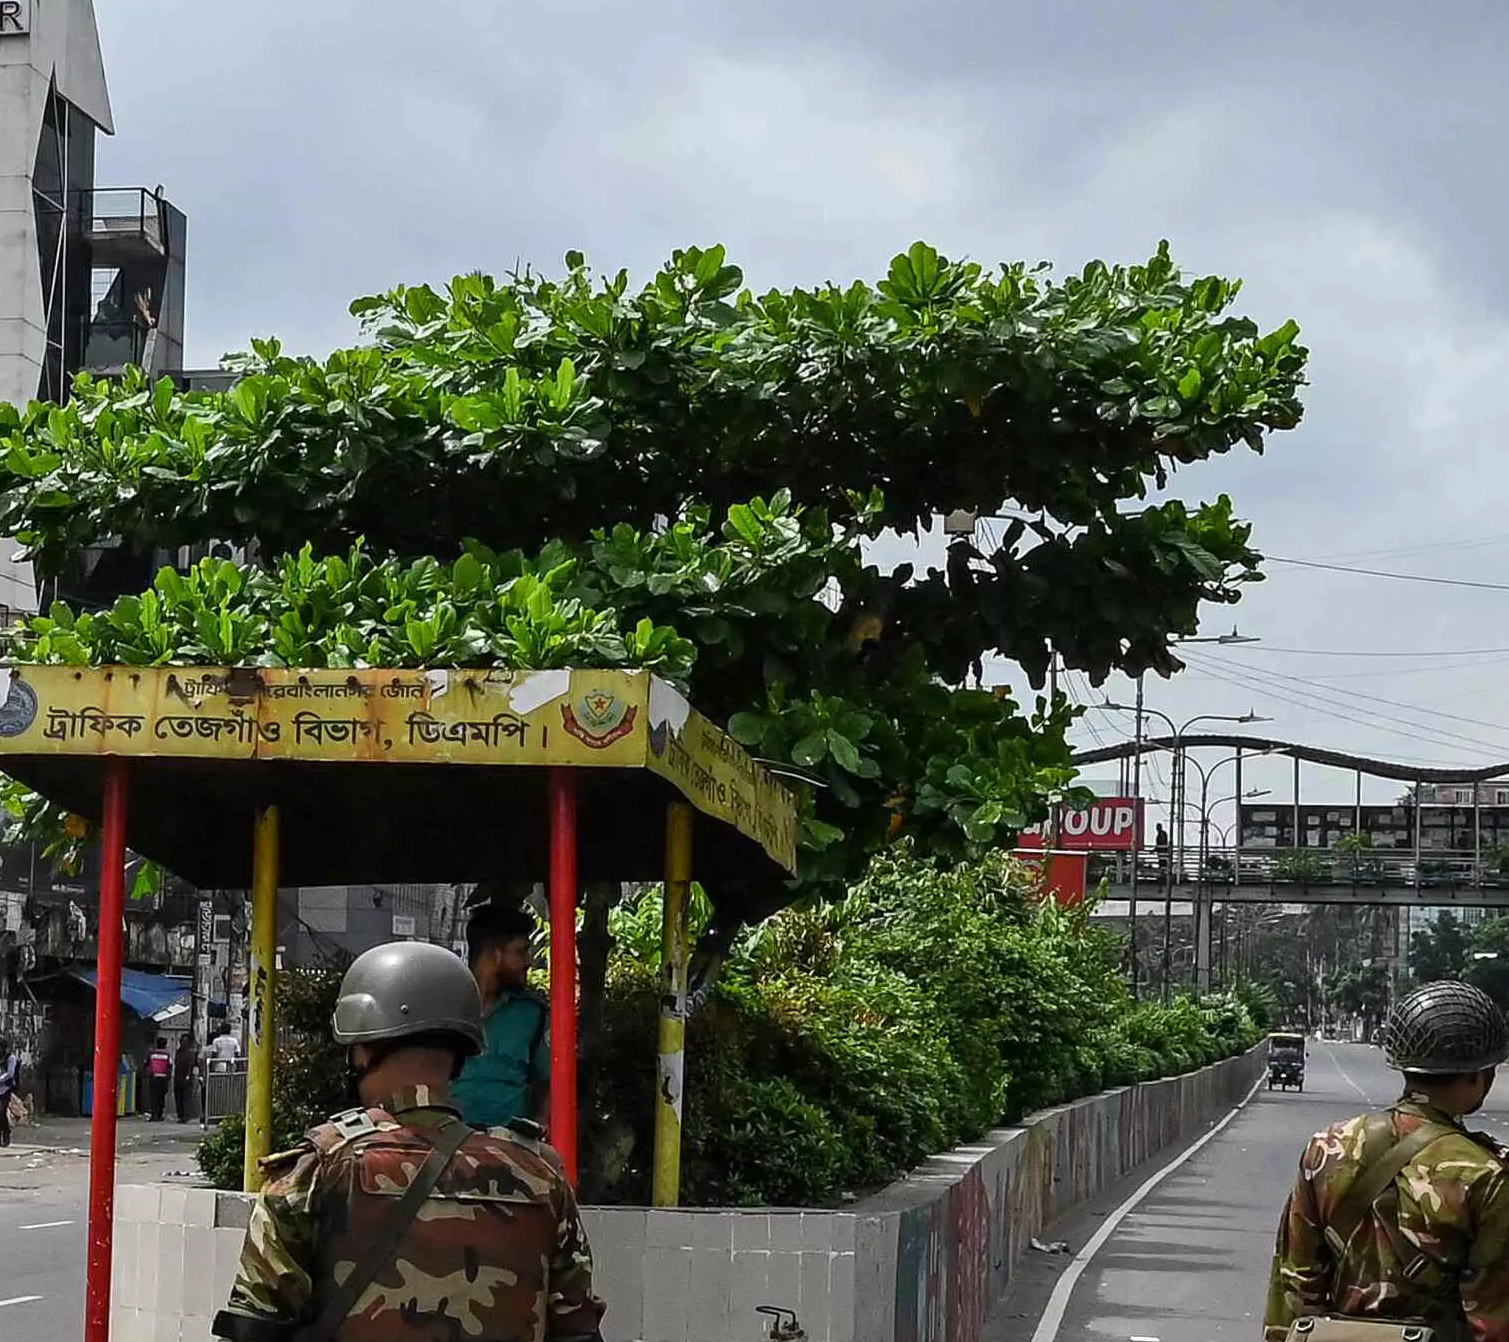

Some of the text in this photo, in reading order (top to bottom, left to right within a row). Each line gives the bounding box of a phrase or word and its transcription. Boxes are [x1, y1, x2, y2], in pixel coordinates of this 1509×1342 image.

[184, 676, 223, 698] ট্রাফি
[43, 706, 146, 742] ট্রাফিক
[154, 707, 281, 744] তেজগাঁও
[405, 711, 531, 749] ডিএমপি
[1023, 806, 1134, 836] OUP
